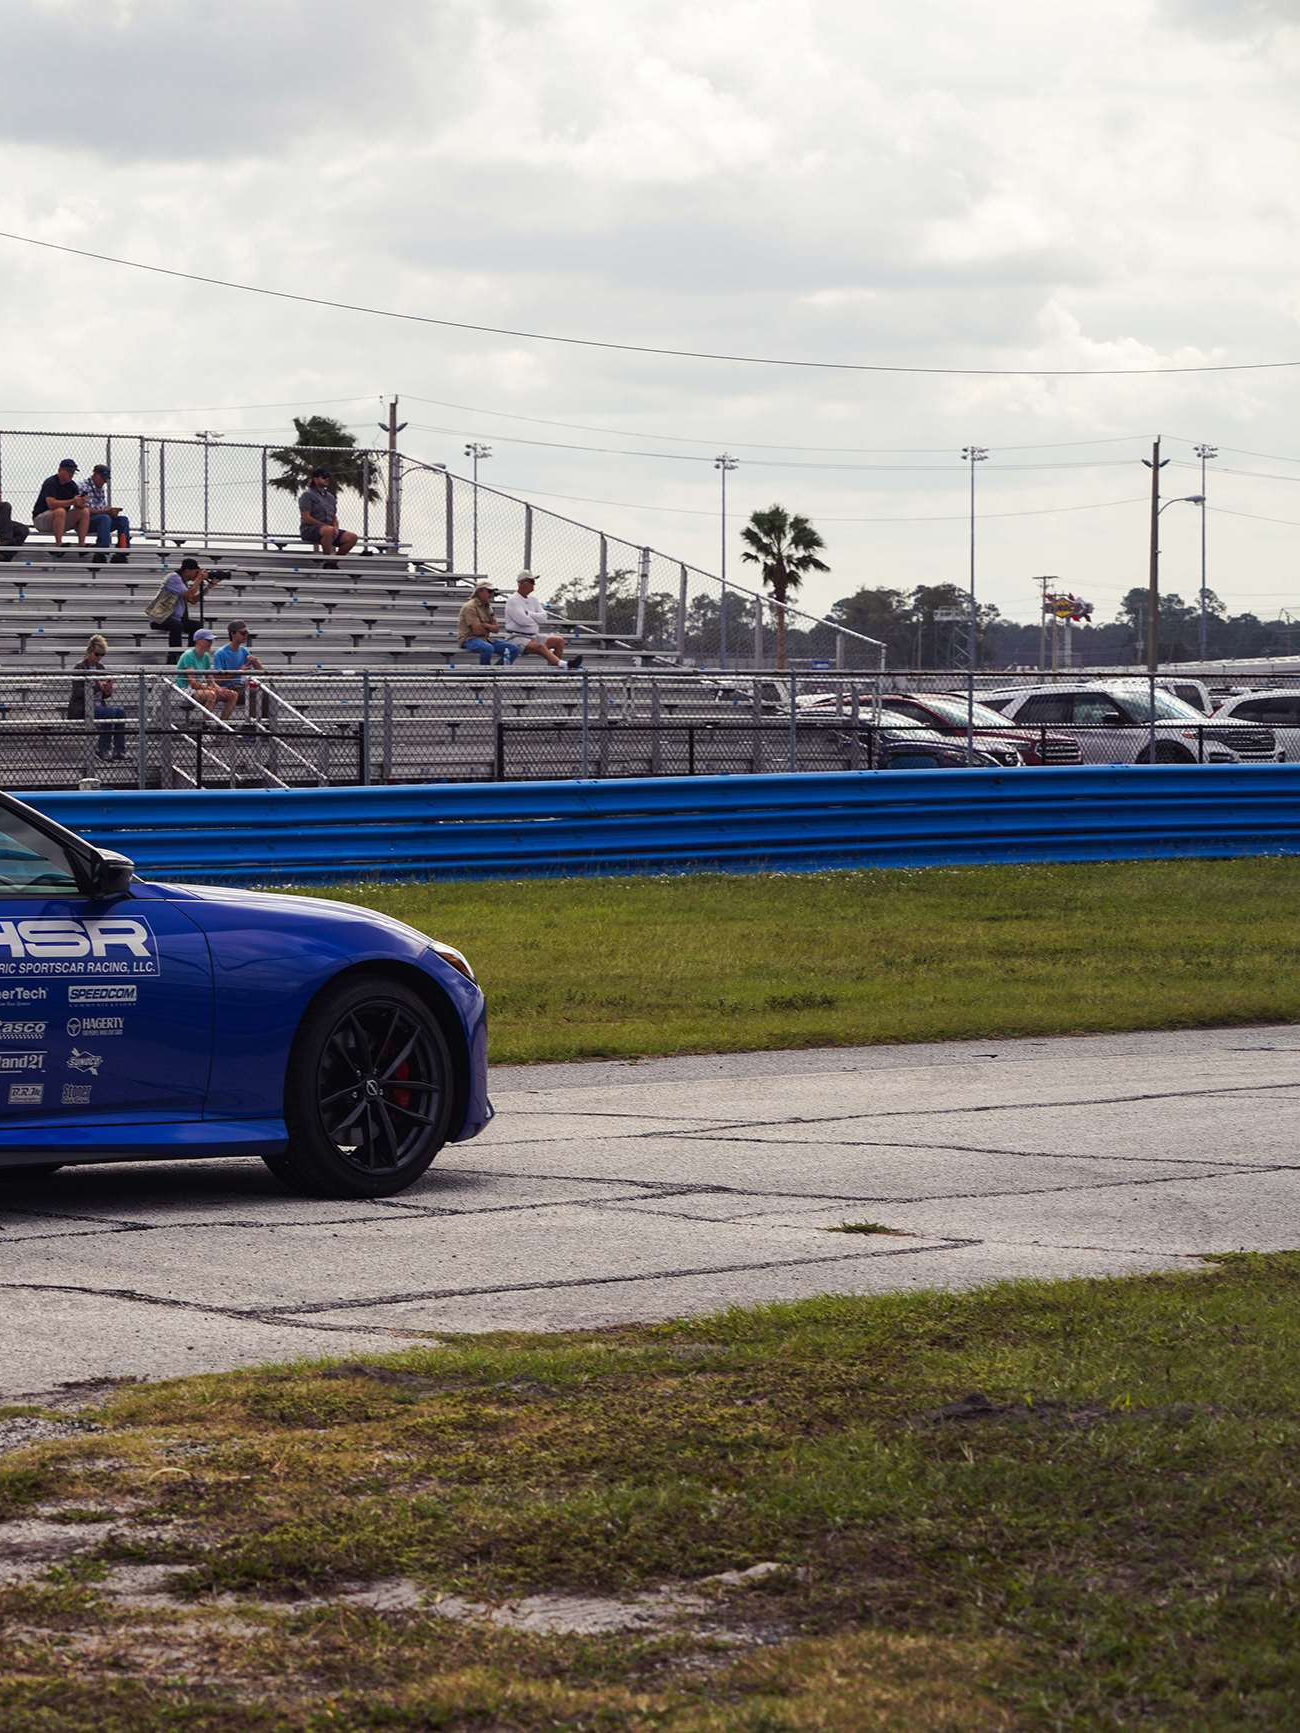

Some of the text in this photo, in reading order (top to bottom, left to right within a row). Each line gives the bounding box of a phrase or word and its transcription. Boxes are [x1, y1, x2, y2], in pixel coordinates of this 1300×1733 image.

[19, 962, 85, 974] SPORTSCAR
[87, 962, 130, 974] RACING,
[133, 961, 156, 972] LLC.
[70, 988, 135, 1000] SPEEDCOM
[82, 1017, 124, 1029] HAGERTY
